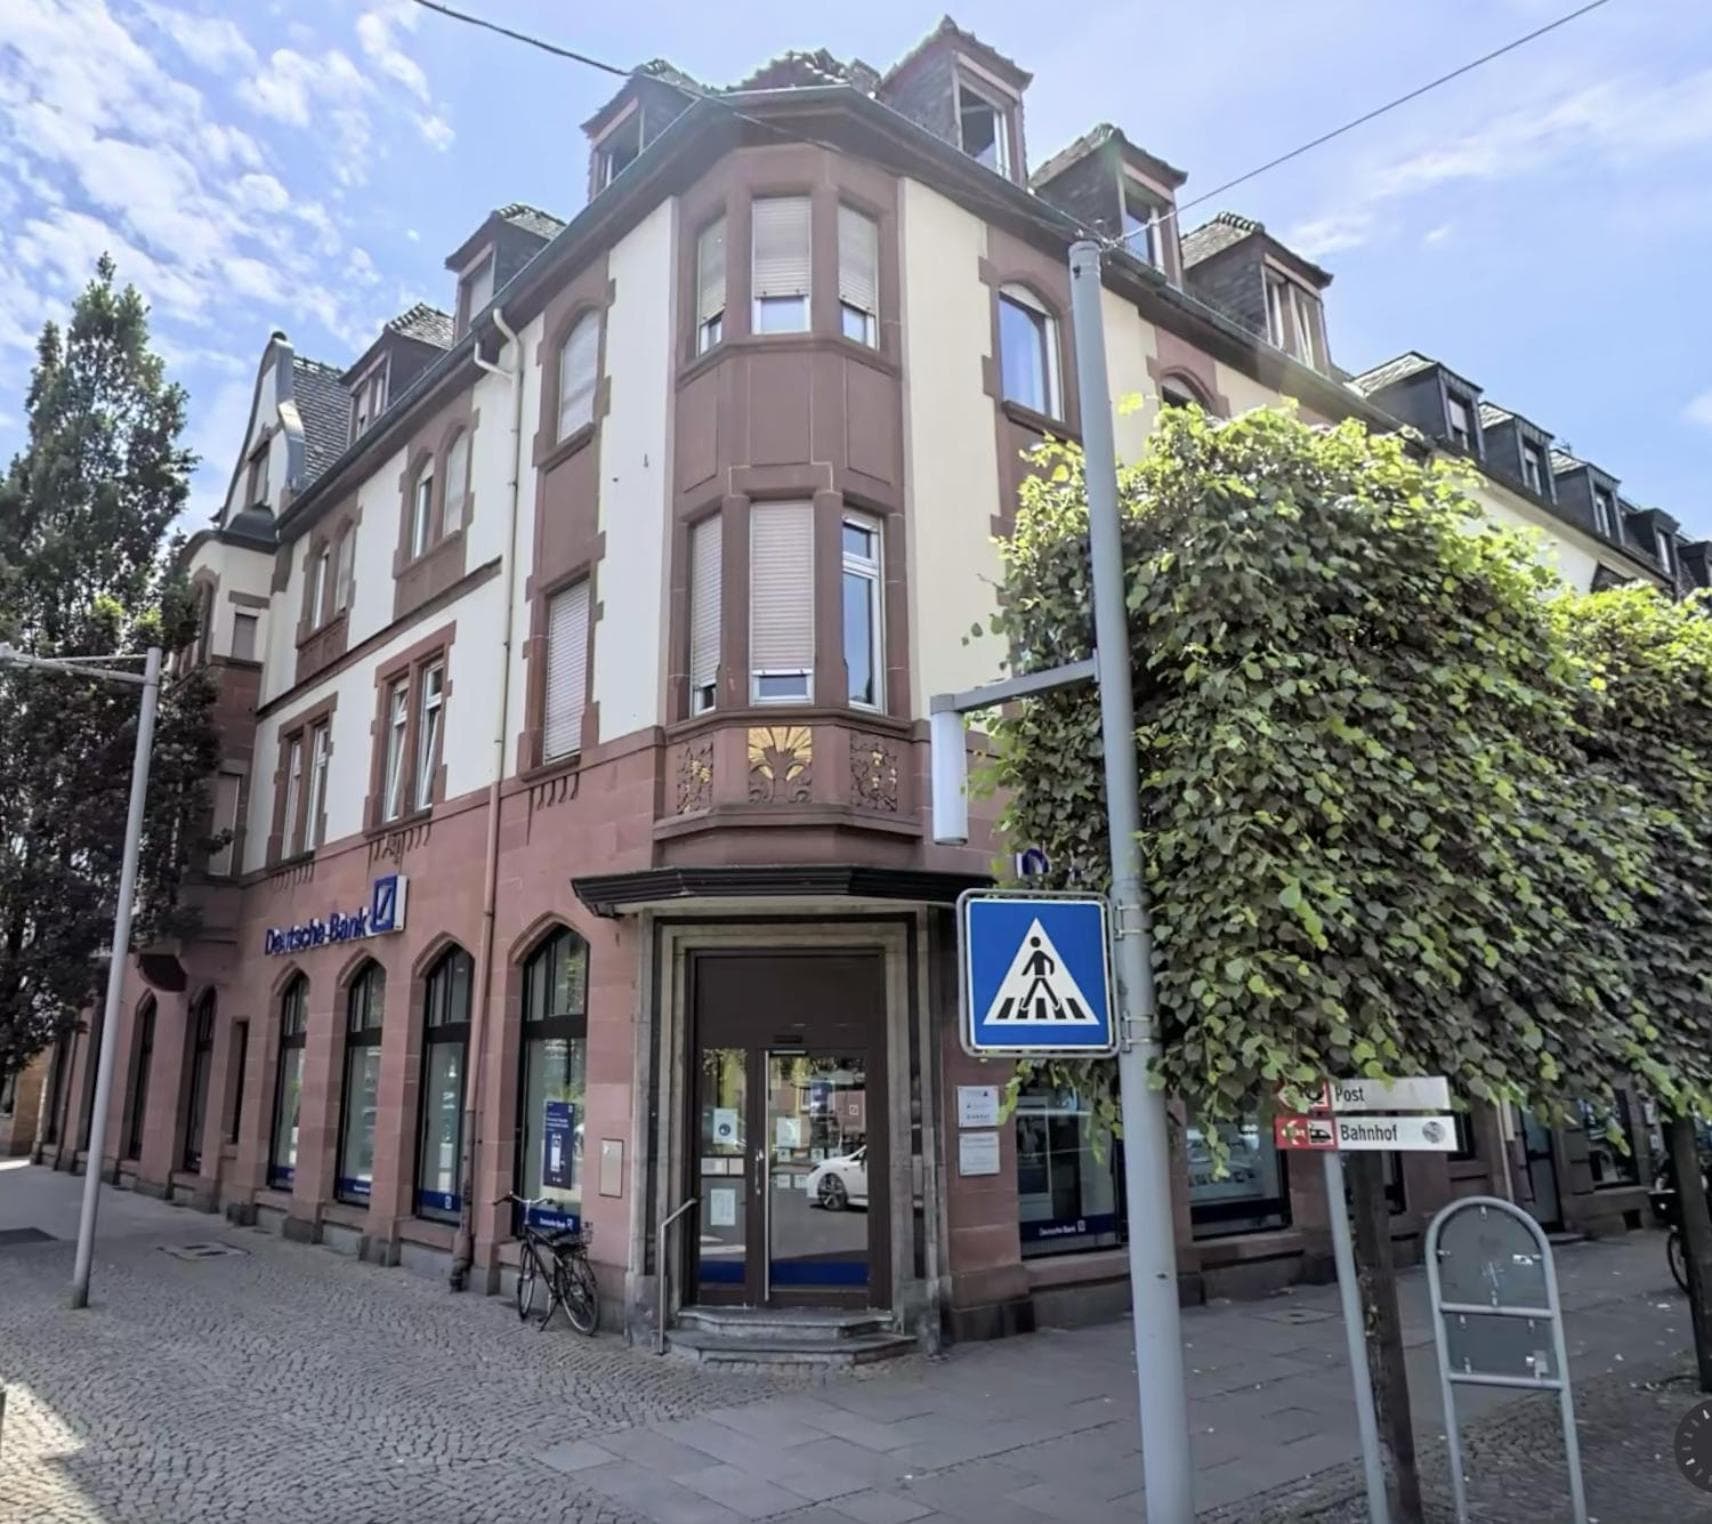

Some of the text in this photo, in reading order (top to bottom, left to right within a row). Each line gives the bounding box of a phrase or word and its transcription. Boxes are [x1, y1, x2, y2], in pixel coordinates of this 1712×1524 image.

[265, 907, 368, 955] Deutsche Bank
[1335, 1086, 1365, 1102] Post
[1340, 1124, 1397, 1141] Bahnhof
